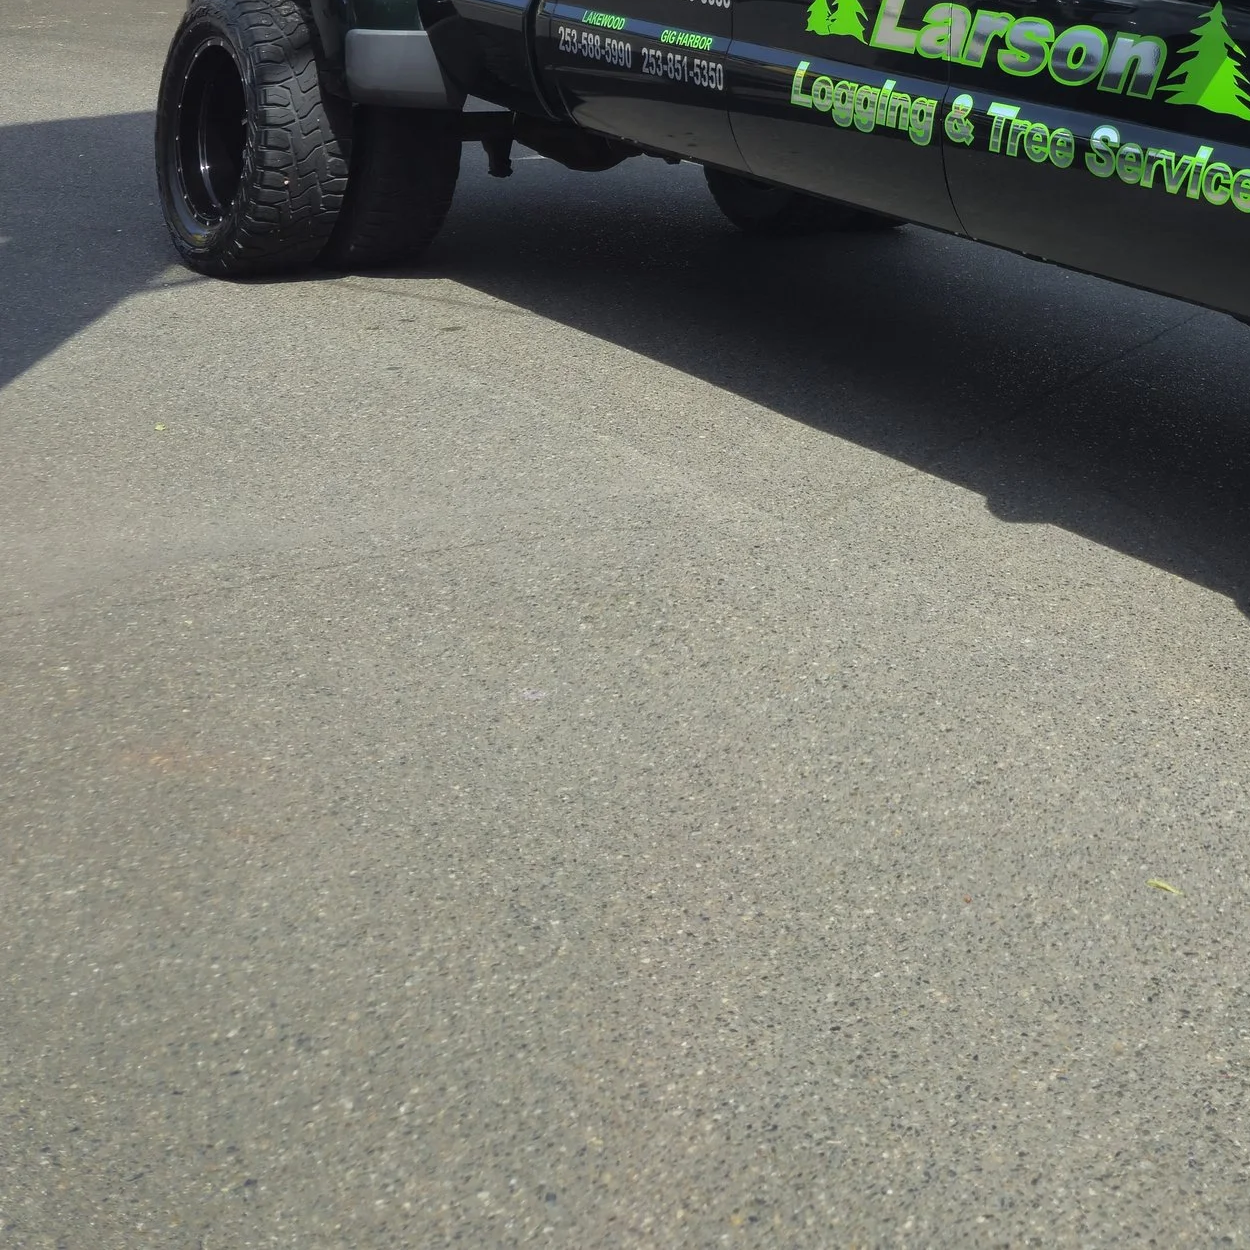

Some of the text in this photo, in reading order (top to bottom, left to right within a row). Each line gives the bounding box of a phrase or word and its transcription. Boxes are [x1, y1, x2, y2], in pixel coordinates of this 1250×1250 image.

[581, 10, 626, 30] LAKEWOOD
[660, 29, 713, 51] GIG HARBOR
[558, 26, 632, 69] 253-588-5990
[641, 47, 724, 91] 253-851-5350
[790, 60, 939, 146] Logging
[944, 93, 974, 147] &
[985, 101, 1075, 169] Tree
